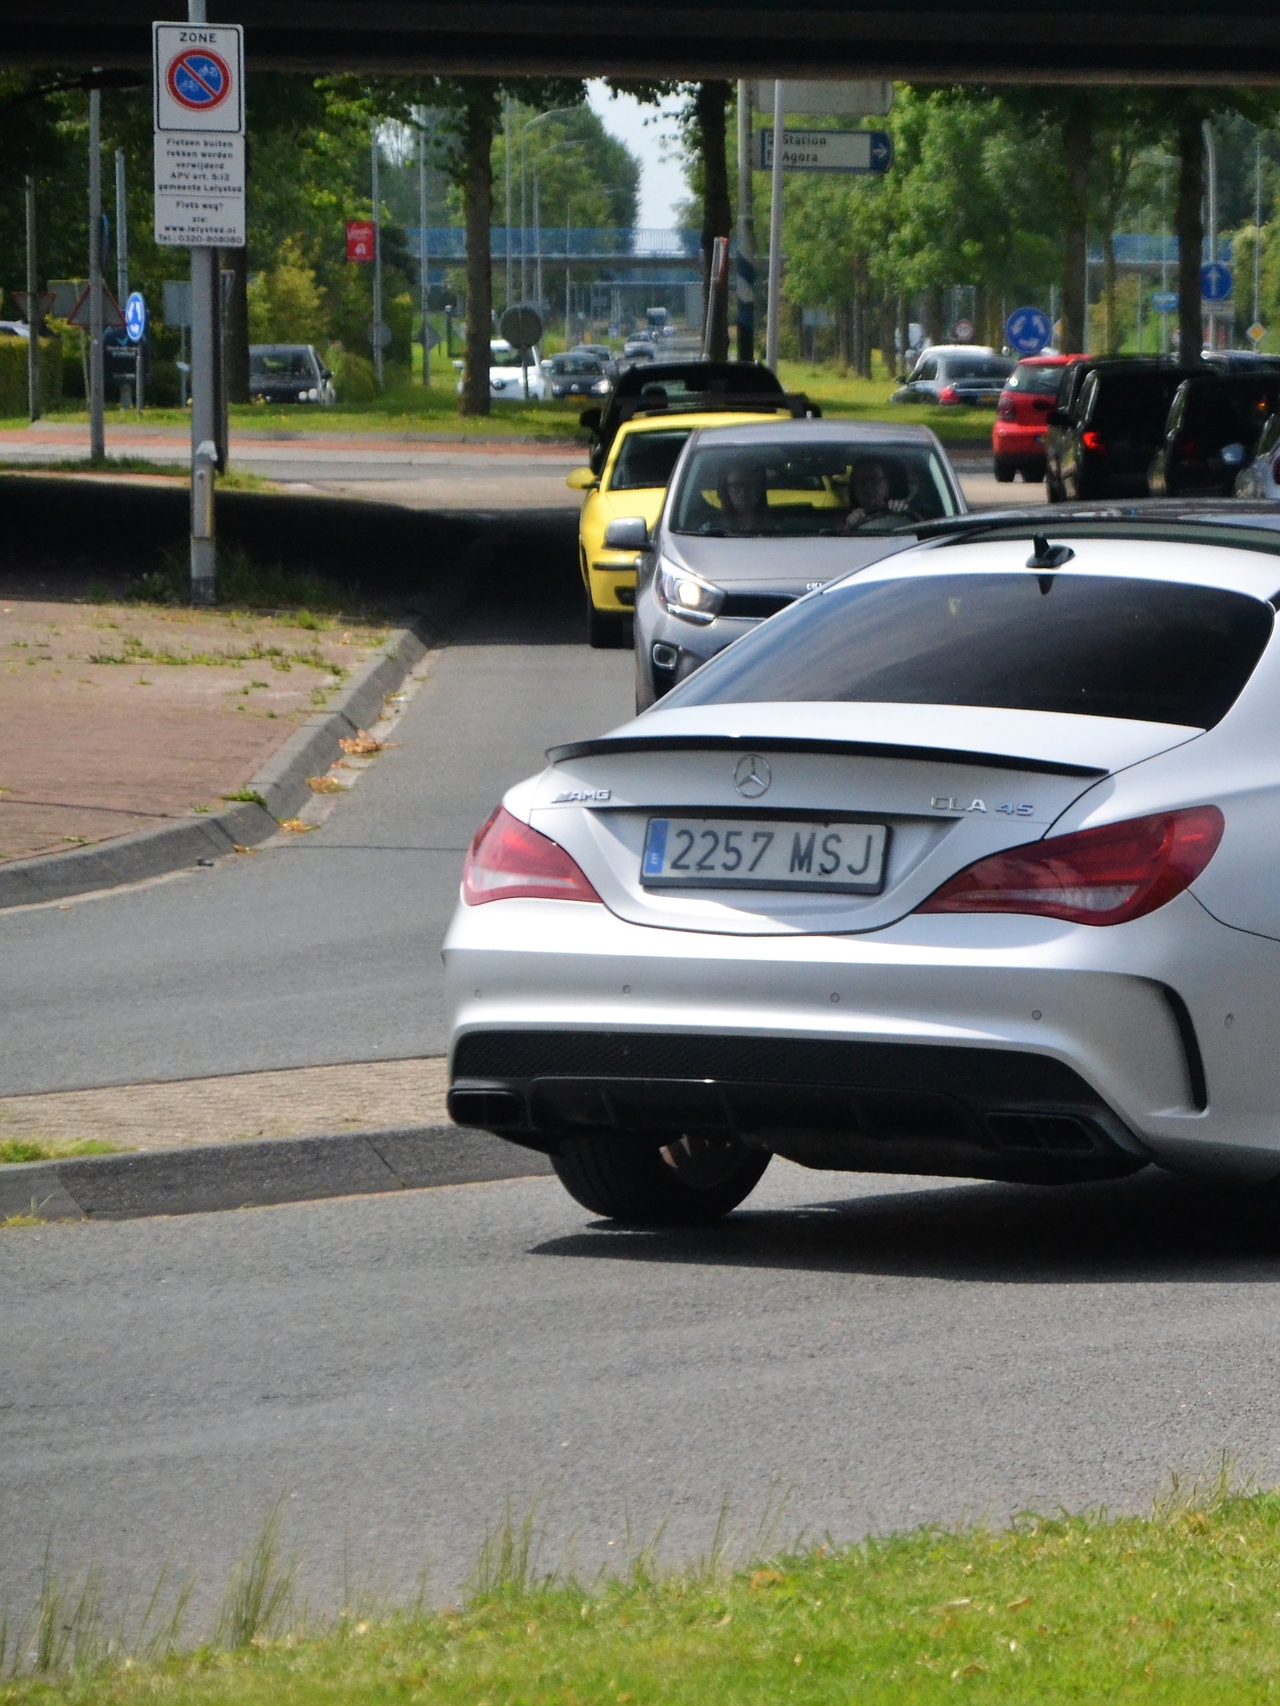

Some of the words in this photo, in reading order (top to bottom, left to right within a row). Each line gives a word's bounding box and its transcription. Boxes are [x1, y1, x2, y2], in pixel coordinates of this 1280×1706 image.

[180, 32, 217, 44] ZONE
[167, 138, 200, 146] Fietsen
[203, 139, 233, 148] buiten
[783, 133, 827, 145] Station
[201, 151, 233, 159] worden
[782, 150, 818, 164] Agora
[176, 162, 224, 170] verwijderd
[170, 172, 190, 180] APV
[158, 184, 201, 192] gemeente
[204, 185, 242, 193] Lelystad
[164, 225, 236, 234] www.lelystad.nl
[571, 789, 611, 801] AMG
[930, 797, 988, 814] CLA
[995, 802, 1035, 817] 45
[669, 829, 775, 873] 2257
[789, 831, 873, 876] MSJ
